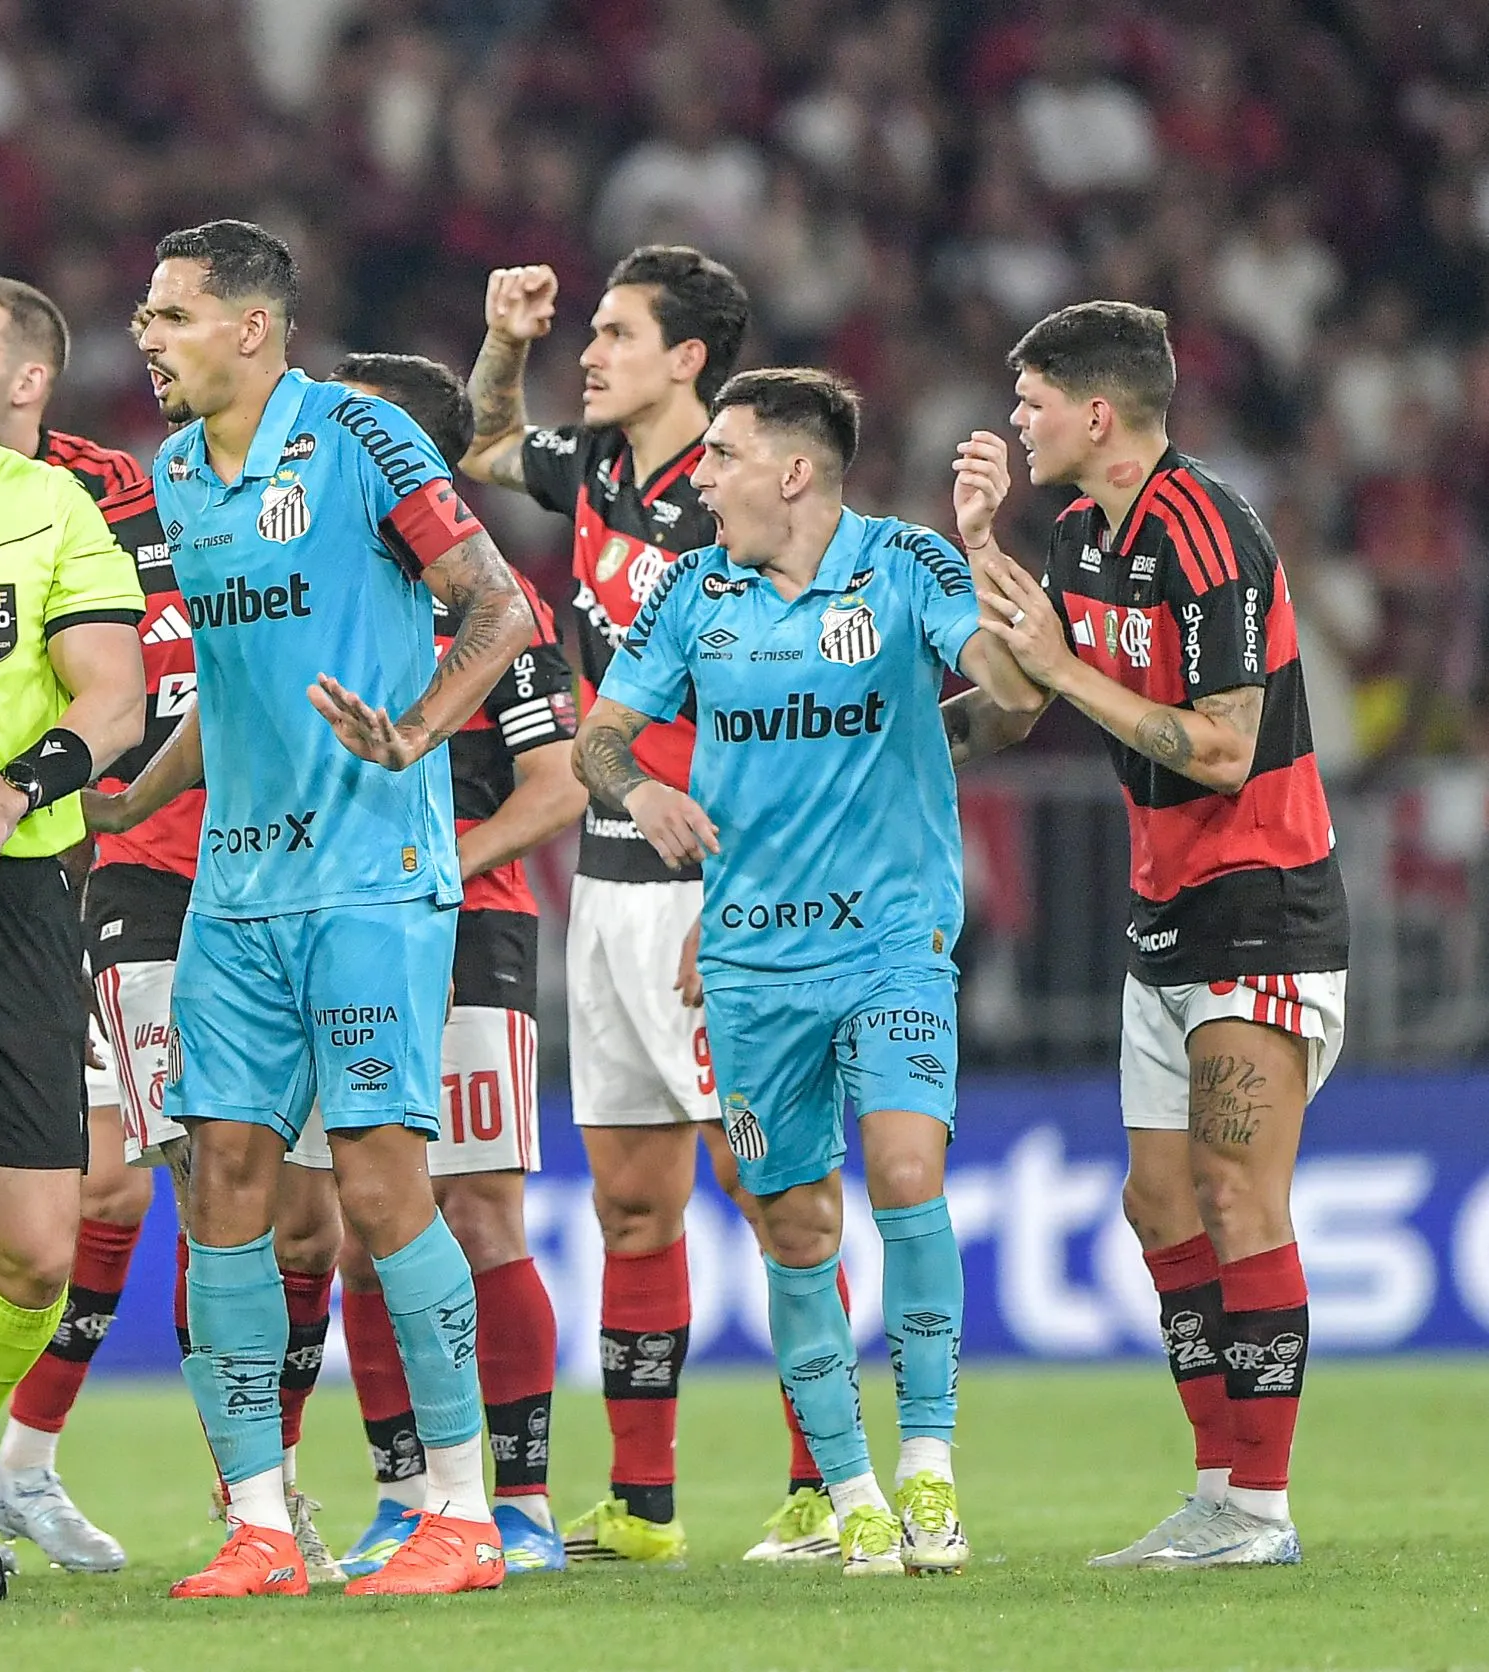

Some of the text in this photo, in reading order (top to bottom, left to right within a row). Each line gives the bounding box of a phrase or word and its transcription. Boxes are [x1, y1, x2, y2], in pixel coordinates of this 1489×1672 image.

[327, 397, 426, 498] Kicaldo
[1243, 586, 1260, 674] Shopee
[713, 690, 886, 743] novibet
[207, 810, 317, 855] CORPX
[721, 890, 865, 930] CORPX
[314, 1002, 399, 1029] VITÓRIA
[866, 1006, 953, 1036] VITÓRIA
[330, 1027, 375, 1047] CUP
[888, 1026, 937, 1044] CUP
[350, 1081, 389, 1092] umbro
[908, 1071, 945, 1090] umbro
[441, 1069, 503, 1145] 10
[902, 1323, 954, 1338] umbro
[1174, 1337, 1216, 1364] Zé
[791, 1359, 844, 1382] umbro
[1256, 1362, 1298, 1385] Zé
[1253, 1384, 1293, 1393] DELIVERY
[227, 1403, 275, 1416] BY NEY
